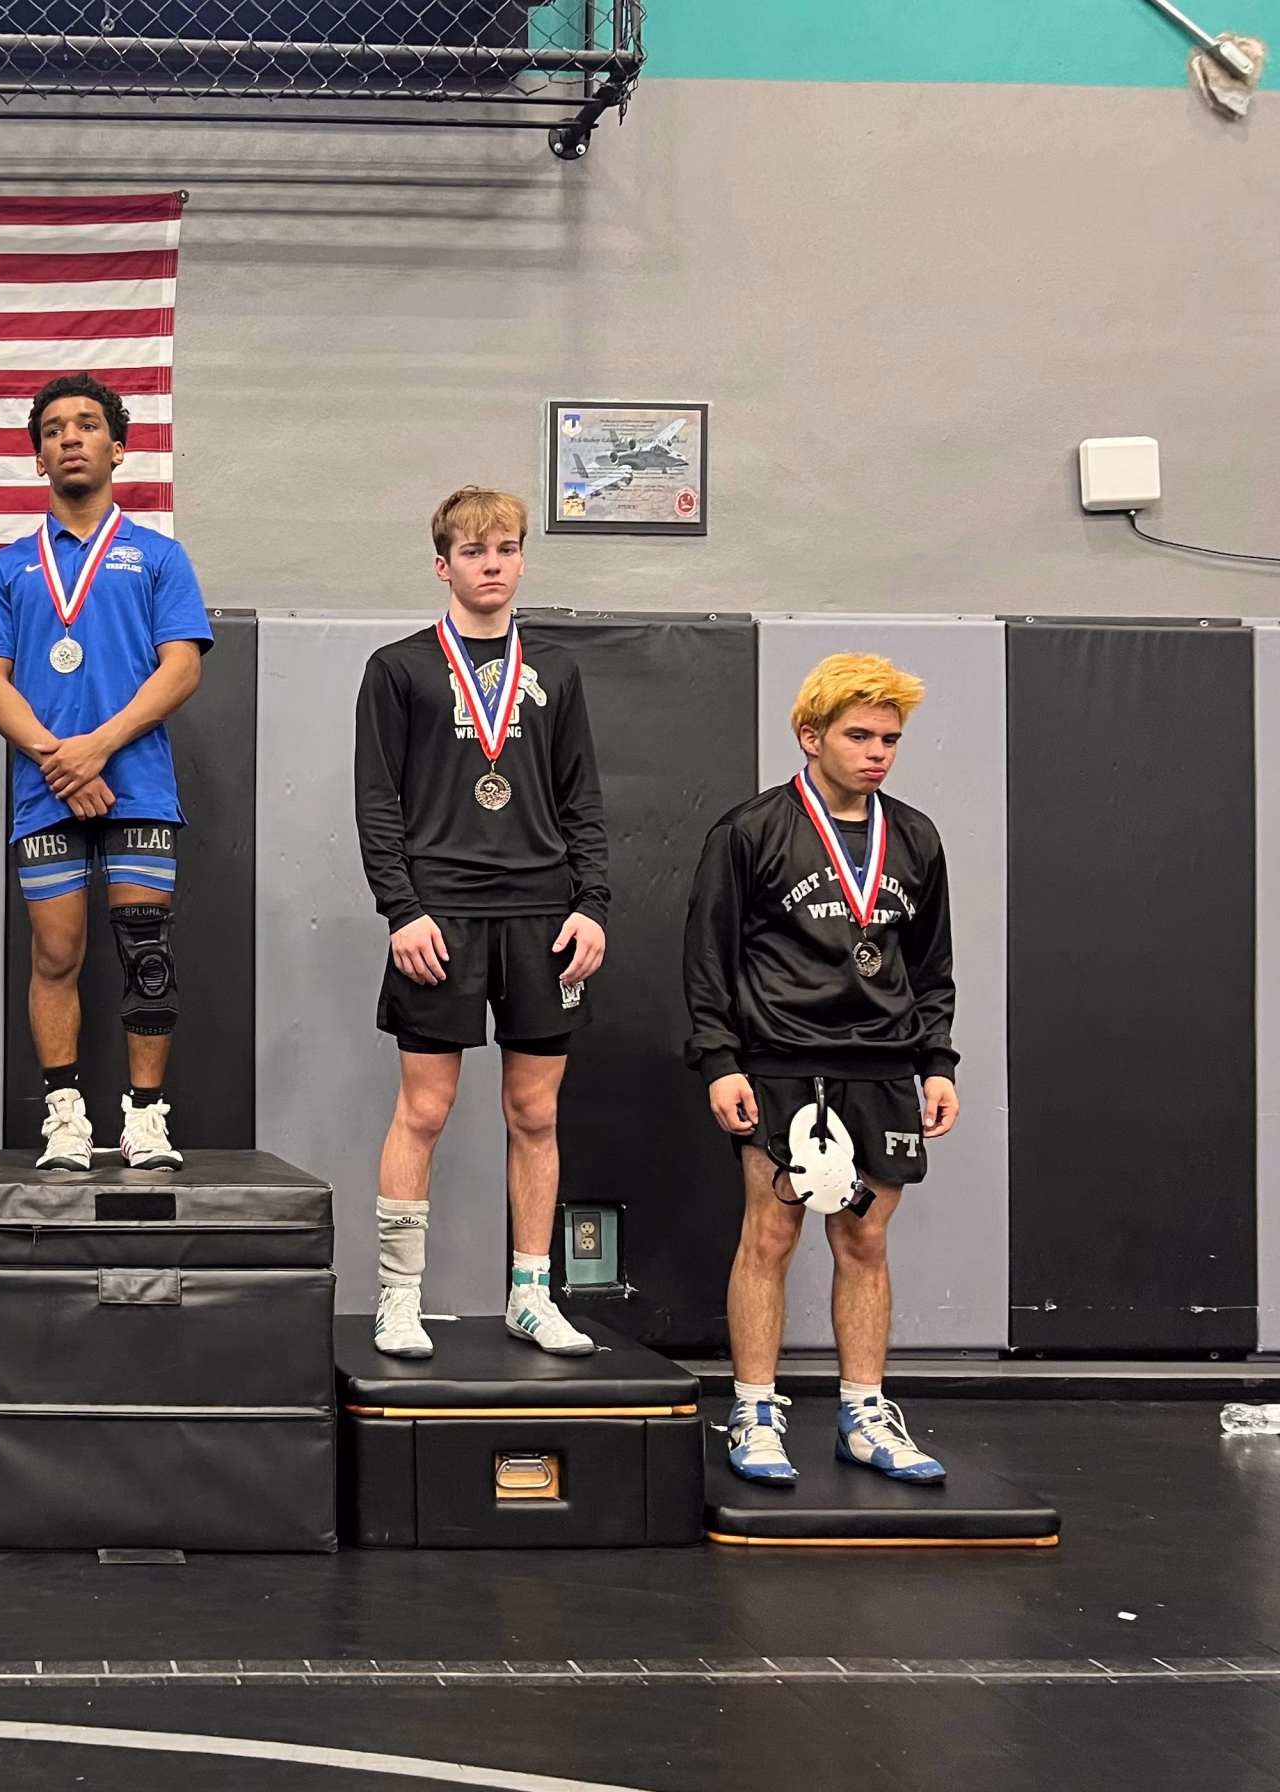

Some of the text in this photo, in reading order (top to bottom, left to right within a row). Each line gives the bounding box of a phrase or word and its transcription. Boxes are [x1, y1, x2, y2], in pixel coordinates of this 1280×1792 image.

[22, 828, 171, 860] WHS TLAC
[781, 872, 820, 912] FORT
[885, 1131, 920, 1158] FT
